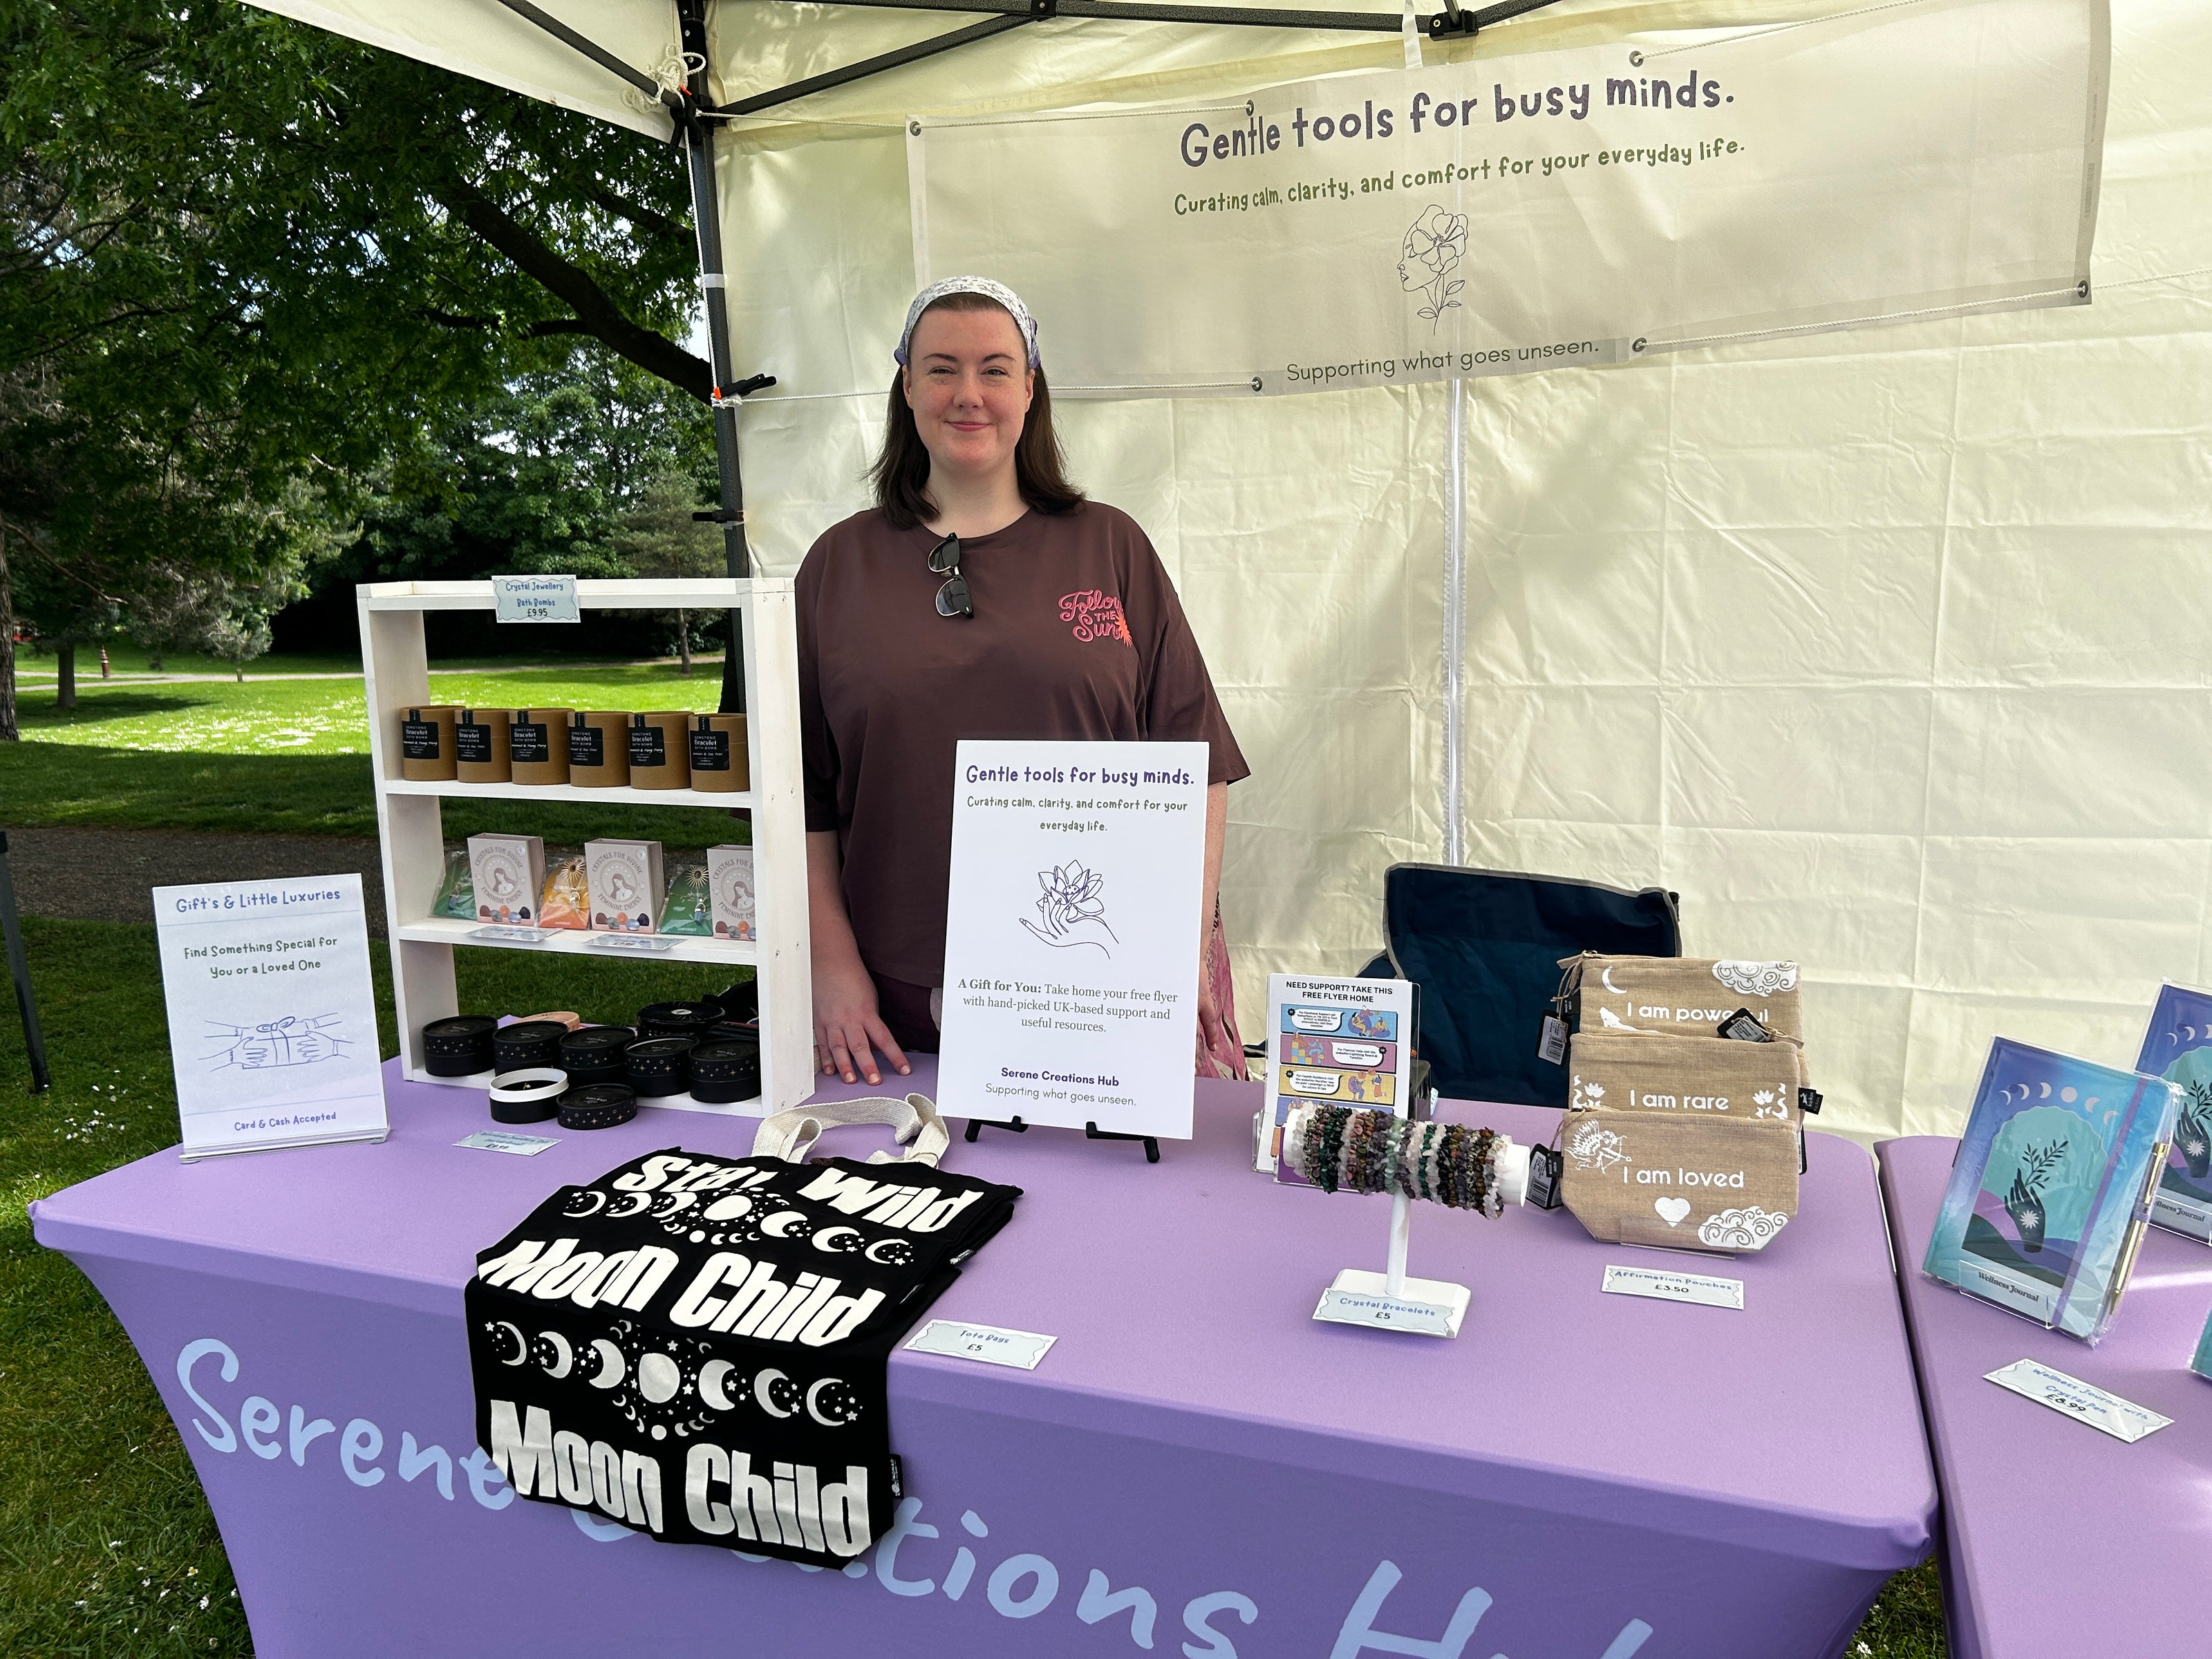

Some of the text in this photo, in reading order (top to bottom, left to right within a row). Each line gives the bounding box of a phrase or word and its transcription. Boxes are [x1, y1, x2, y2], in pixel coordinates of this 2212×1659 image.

[1181, 70, 1734, 167] Gentle tools for busy minds.
[1174, 138, 1745, 215] Curating calm, clarity, and comfort for your everyday life.
[1286, 340, 1600, 384] Supporting what goes unseen.
[506, 582, 563, 591] Crystal Jewellery
[517, 598, 556, 607] Bath Bombs
[527, 608, 547, 617] £9.95
[1094, 610, 1117, 621] THE
[1072, 613, 1121, 642] Sun
[966, 765, 1194, 787] Gentle tools for busy minds.
[967, 796, 1188, 812] Curating calm, clarity, and comfort for your
[1040, 821, 1107, 832] everyday life.
[176, 890, 341, 912] Gift's & Little Luxuries
[184, 937, 337, 959] Find Something Special for
[210, 967, 232, 979] You
[261, 961, 294, 974] Loved
[299, 959, 321, 969] One
[957, 979, 1178, 1004] A Gift for You: Take home your free flyer
[1286, 981, 1393, 995] NEED SUPPORT? TAKE THIS
[1323, 993, 1348, 1002] FLYER
[1349, 995, 1374, 1003] HOME
[963, 996, 1170, 1020] with hand-picked UK-based support and
[1627, 1002, 1768, 1024] I am poweul
[1021, 1017, 1106, 1033] useful resources.
[1001, 1067, 1120, 1087] Serene Creations Hub
[985, 1082, 1137, 1107] Supporting what goes unseen.
[1630, 1089, 1729, 1110] I am rare
[234, 1121, 256, 1132] Card
[269, 1117, 290, 1127] Cash
[293, 1112, 336, 1125] Accepted
[1622, 1165, 1745, 1188] I am loved
[796, 1166, 985, 1233] Wild
[2176, 1208, 2205, 1222] Journal
[1615, 1271, 1732, 1290] Affirmation Pouches
[1655, 1284, 1689, 1293] £3.50
[1978, 1271, 2039, 1302] Wellness Journal
[477, 1237, 886, 1347] Moon Child
[1340, 1297, 1436, 1316] Crystal Bracelets
[1375, 1311, 1391, 1320] £5
[960, 1330, 1010, 1344] Tote Bags
[966, 1343, 983, 1351] £5
[2032, 1368, 2078, 1390] Wellness
[2124, 1407, 2148, 1420] with
[2044, 1394, 2086, 1412] £8.99
[2045, 1385, 2107, 1414] Crystal Pen
[490, 1399, 872, 1557] Moon Child
[176, 1338, 515, 1510] Serene
[570, 1496, 1259, 1659] tions
